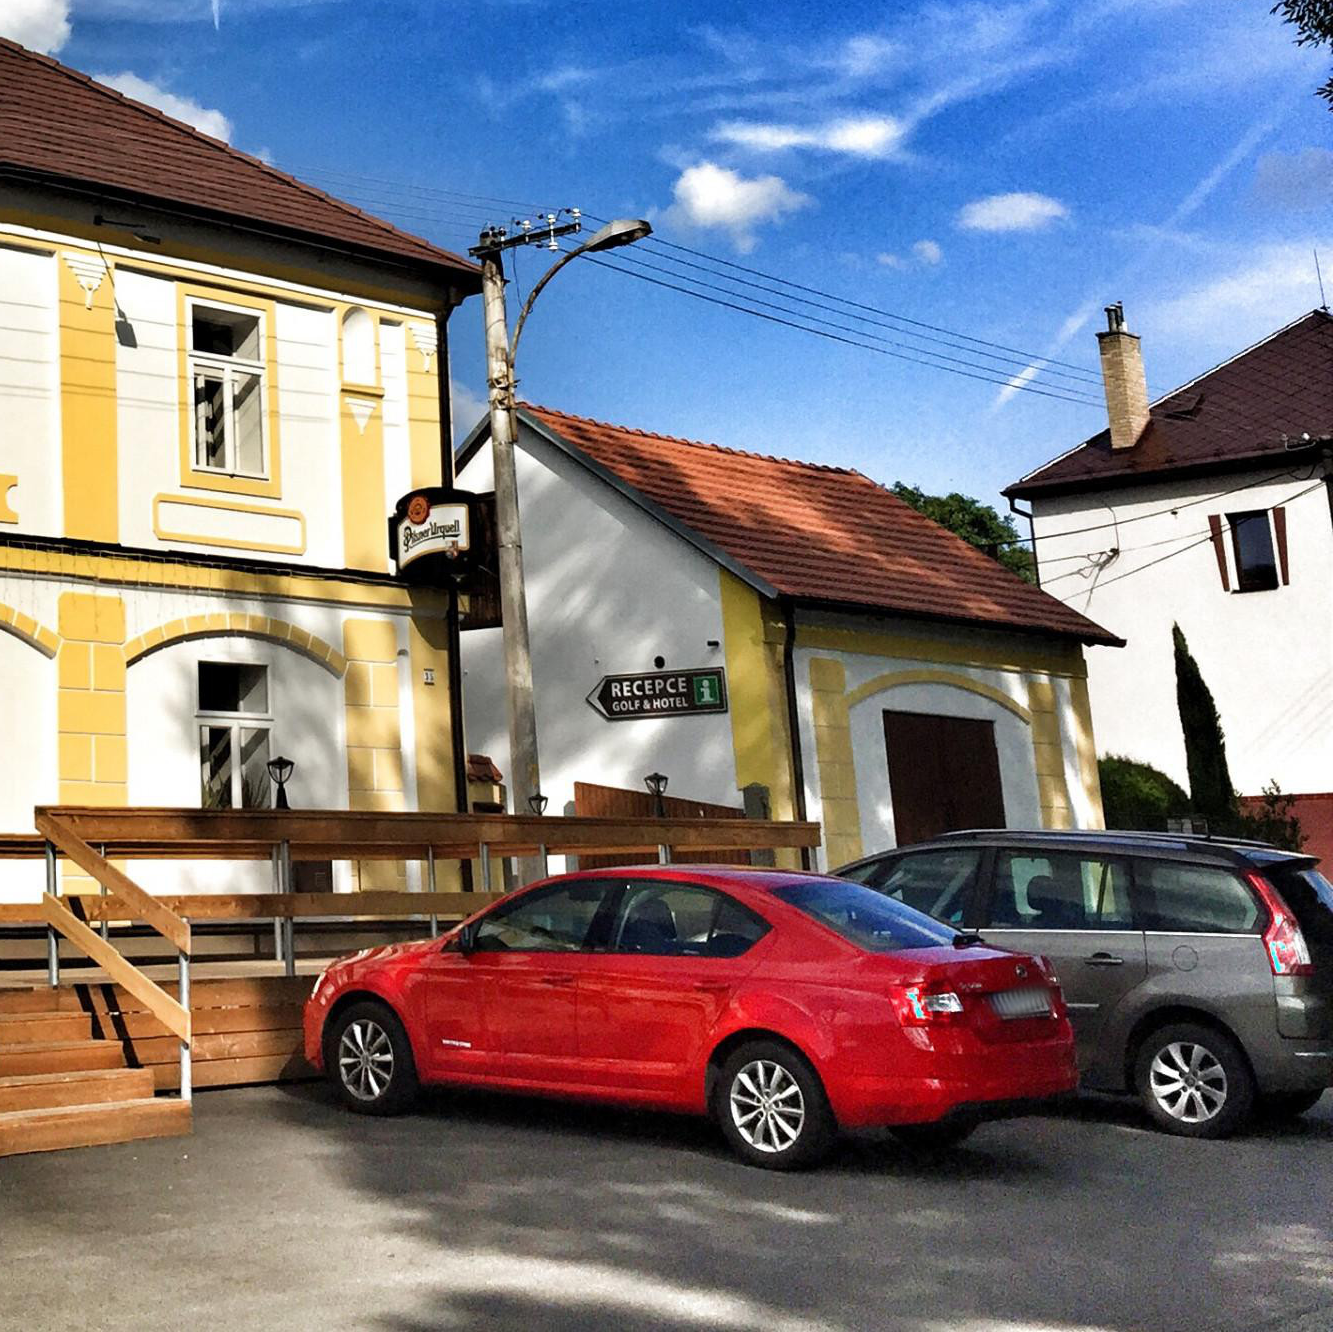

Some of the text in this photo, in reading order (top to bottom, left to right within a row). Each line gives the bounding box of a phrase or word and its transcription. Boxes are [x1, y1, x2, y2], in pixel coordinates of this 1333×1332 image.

[403, 519, 460, 553] Pilsner Urquell
[611, 677, 688, 698] RECEPCE
[612, 696, 689, 712] GOLF & HOTEL
